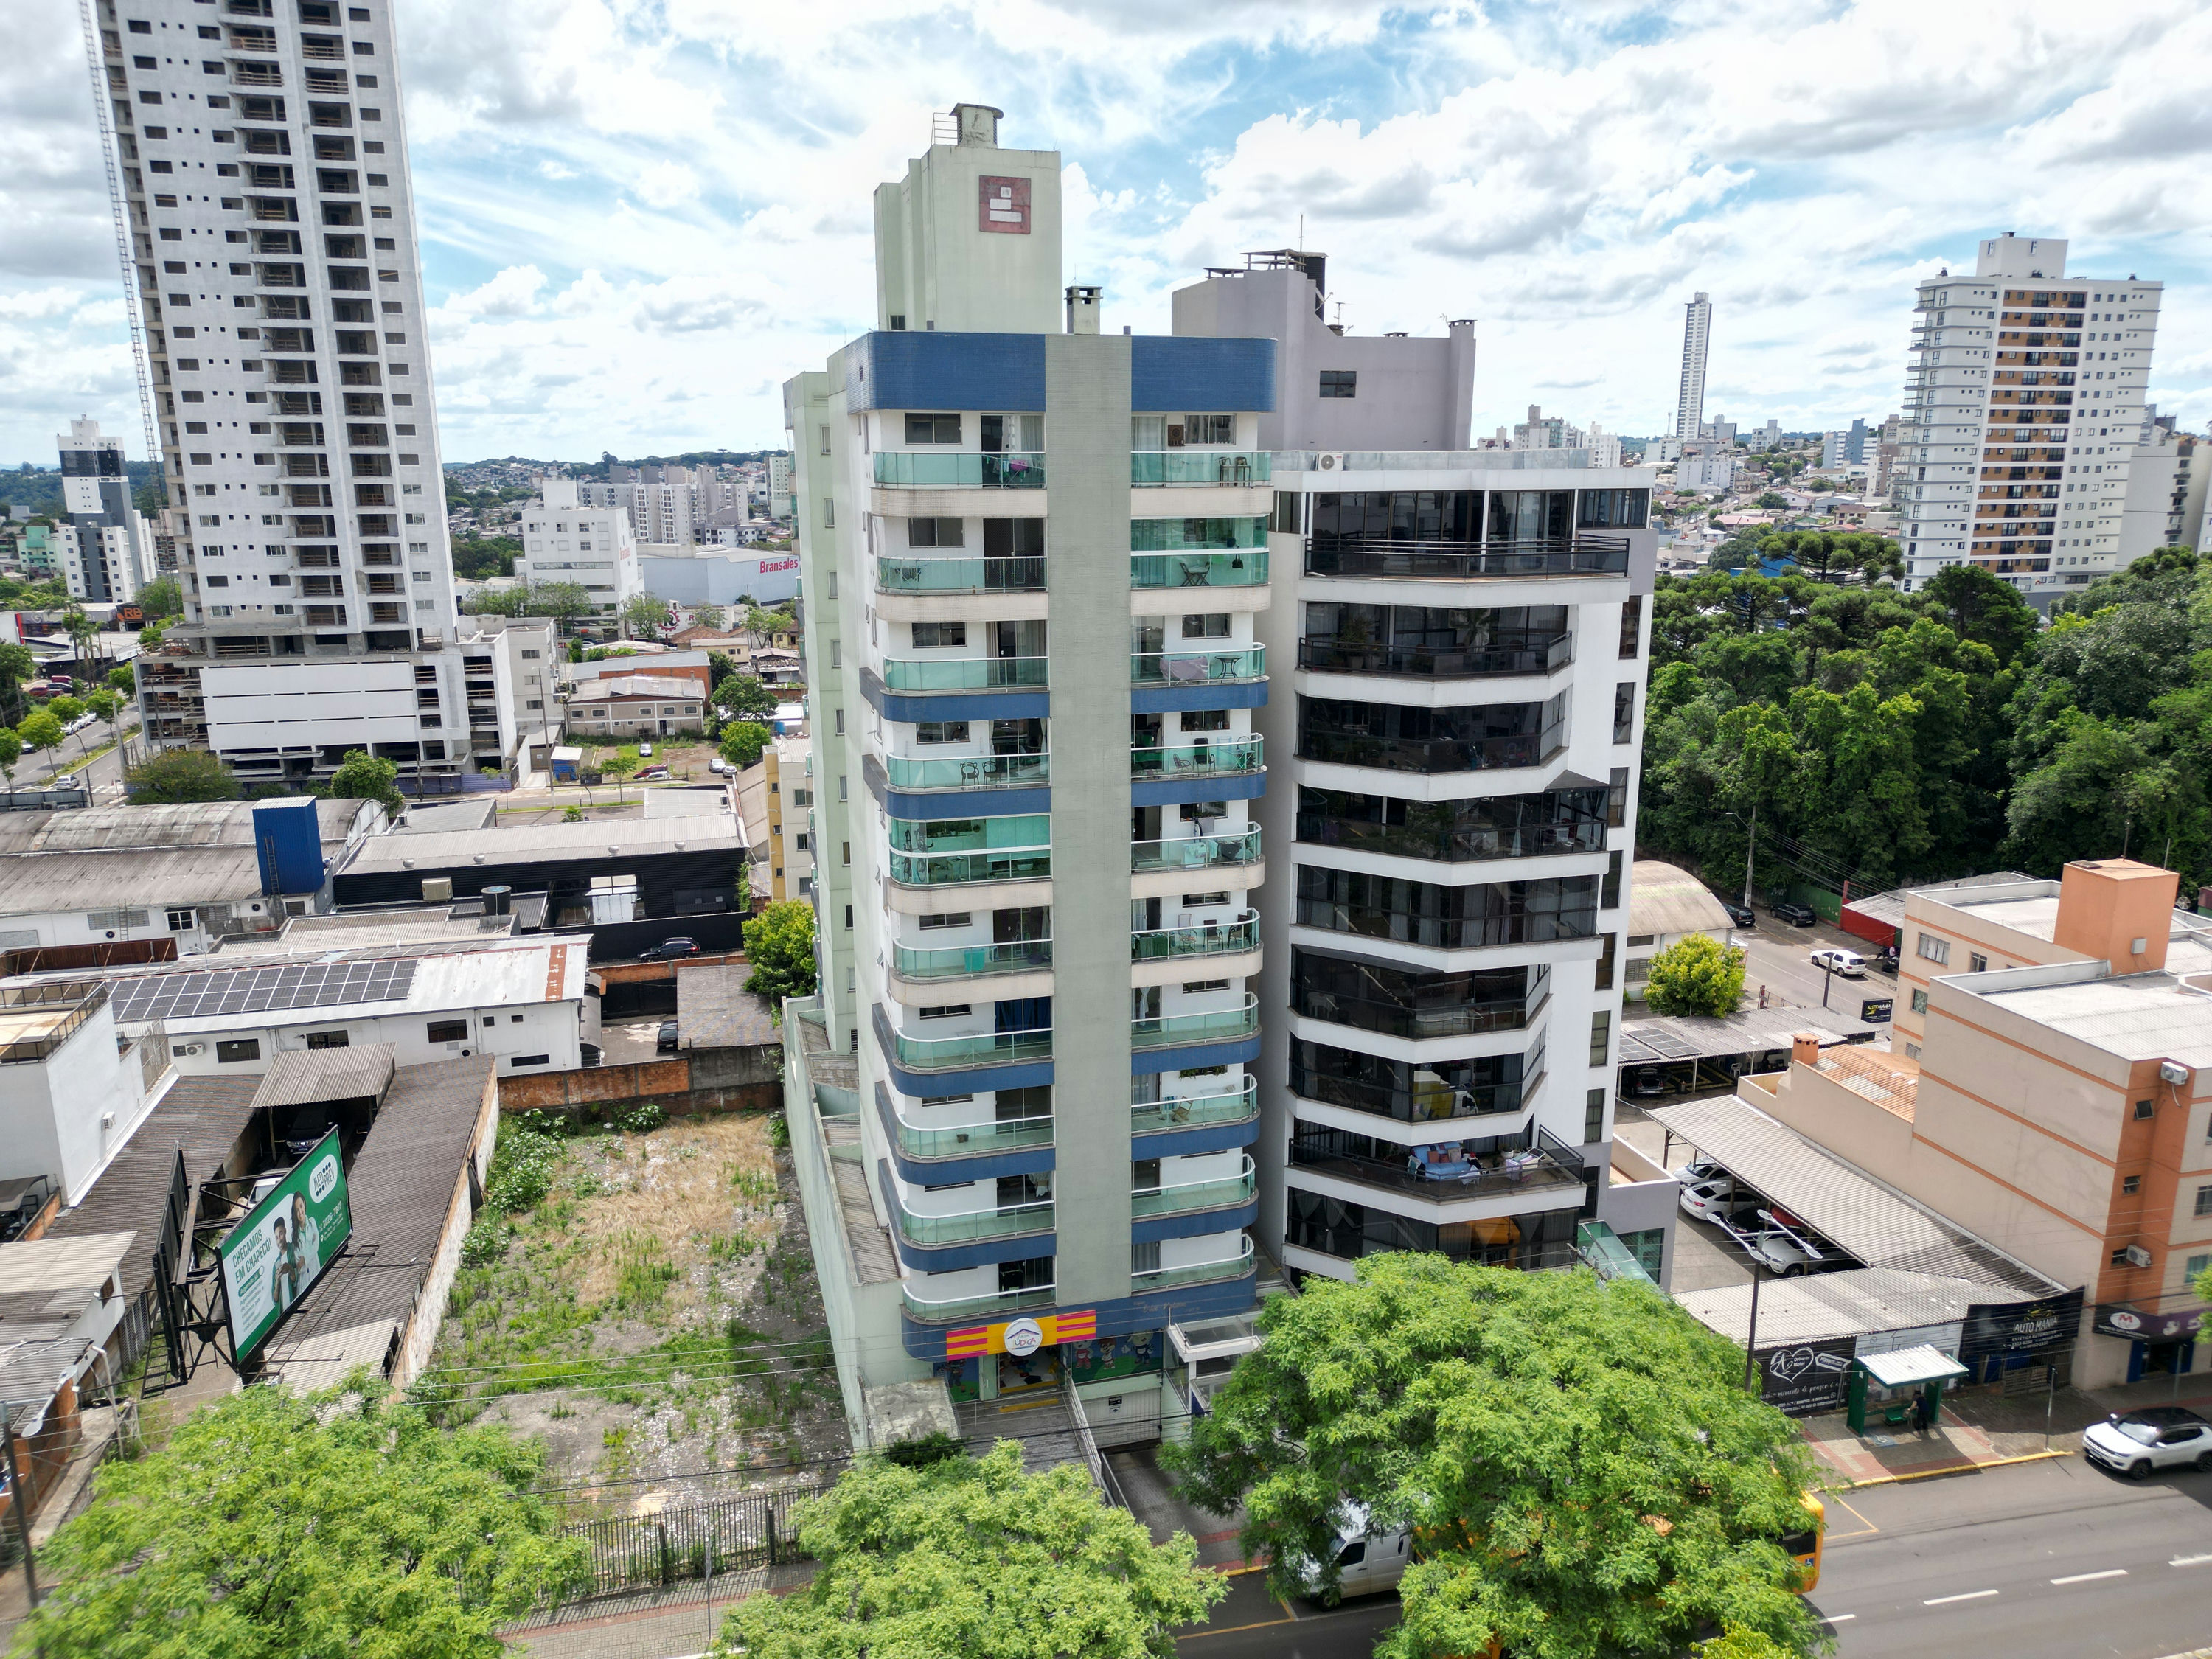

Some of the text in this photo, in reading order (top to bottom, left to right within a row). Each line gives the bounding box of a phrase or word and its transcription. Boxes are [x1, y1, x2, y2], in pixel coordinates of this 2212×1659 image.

[760, 557, 799, 574] Bransales
[124, 608, 142, 618] RB
[313, 1171, 324, 1191] MED
[324, 1166, 335, 1189] PREV
[232, 1228, 263, 1267] CHEGAMOS
[246, 1237, 272, 1273] CHAPECÓ!
[235, 1265, 246, 1284] EM
[2014, 1316, 2058, 1333] AUTO MANIA
